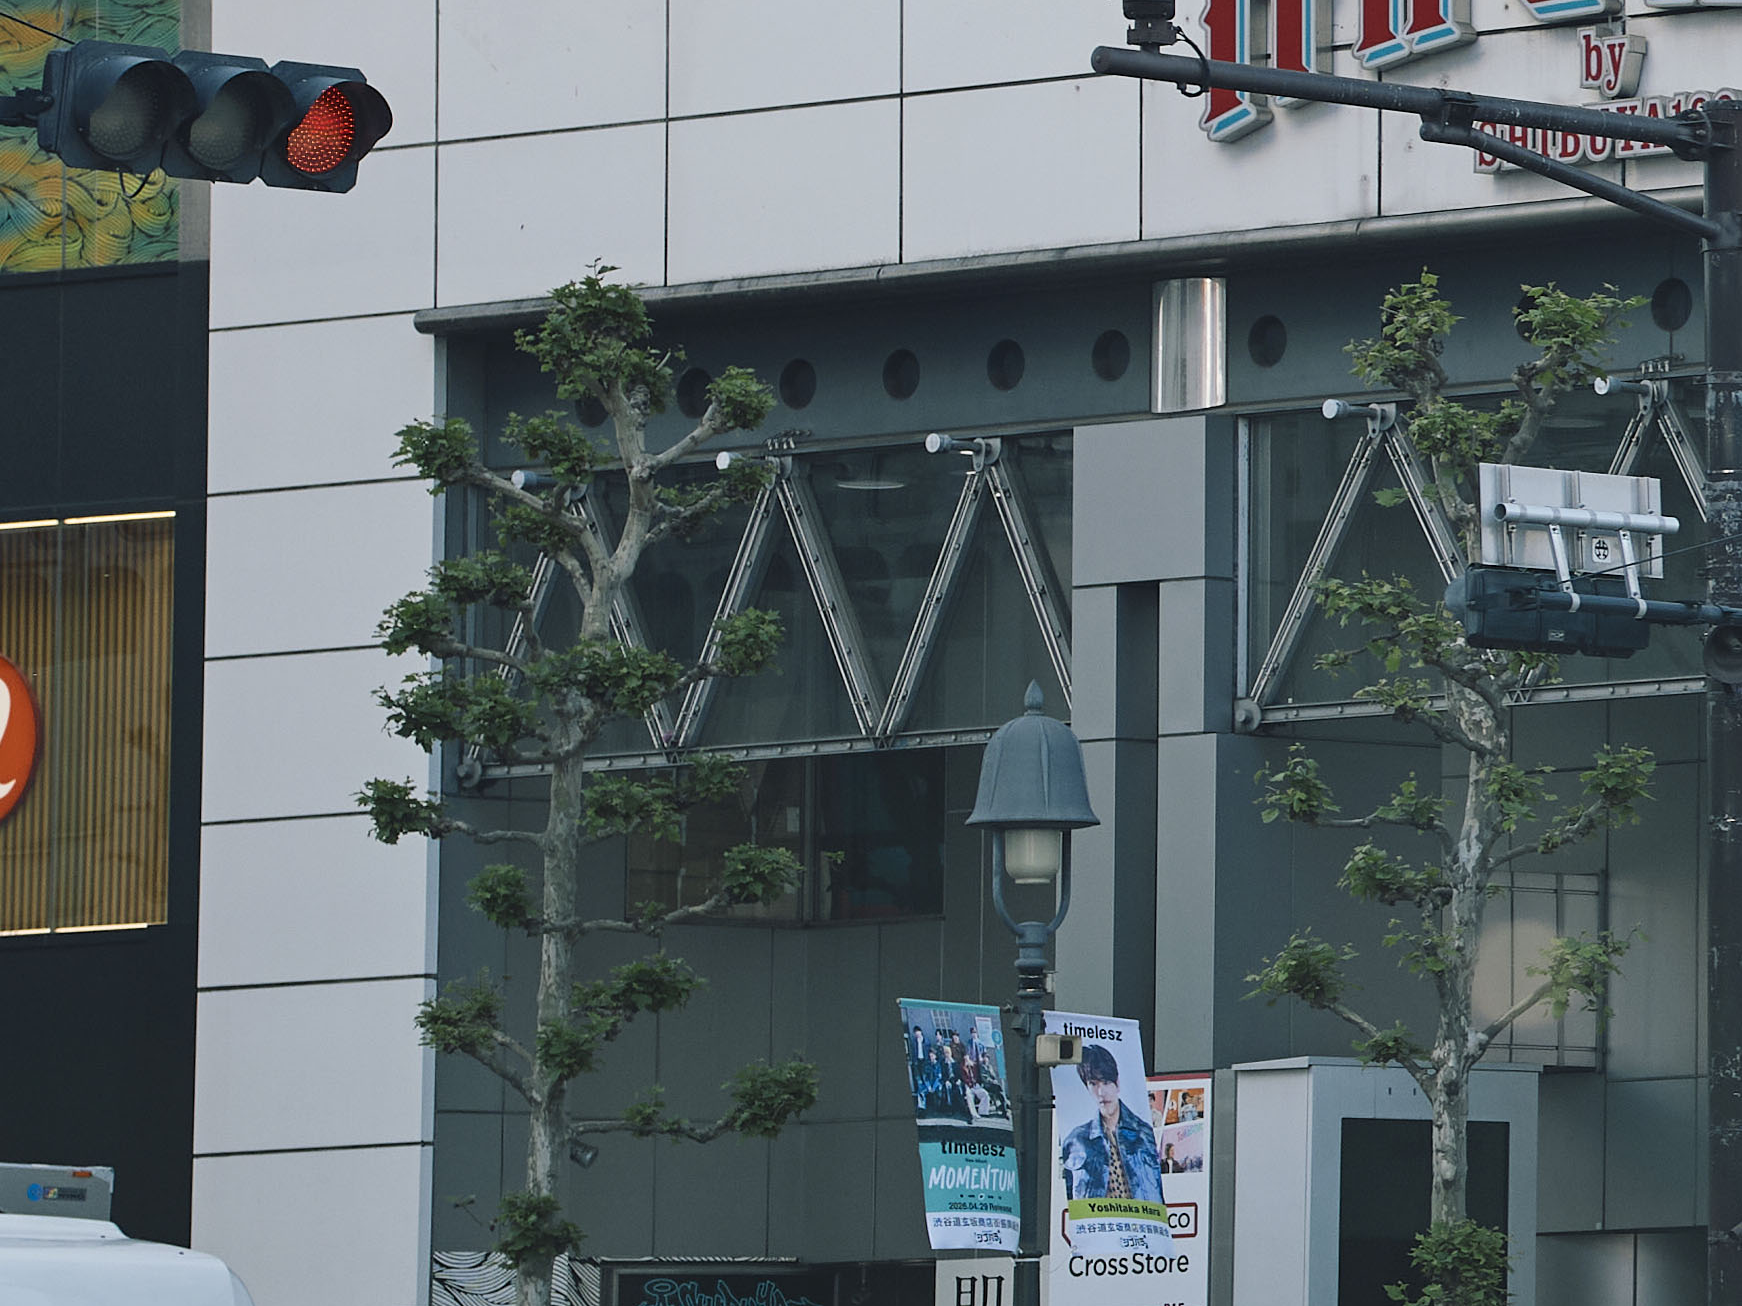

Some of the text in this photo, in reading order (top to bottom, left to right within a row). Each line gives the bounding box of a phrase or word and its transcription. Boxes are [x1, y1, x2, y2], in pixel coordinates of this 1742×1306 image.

[1578, 26, 1641, 97] by
[1063, 1022, 1123, 1042] timelesz
[928, 1164, 1016, 1193] MOMENTUM
[1088, 1202, 1141, 1214] Yoshitaka
[1068, 1250, 1189, 1278] Cross Store
